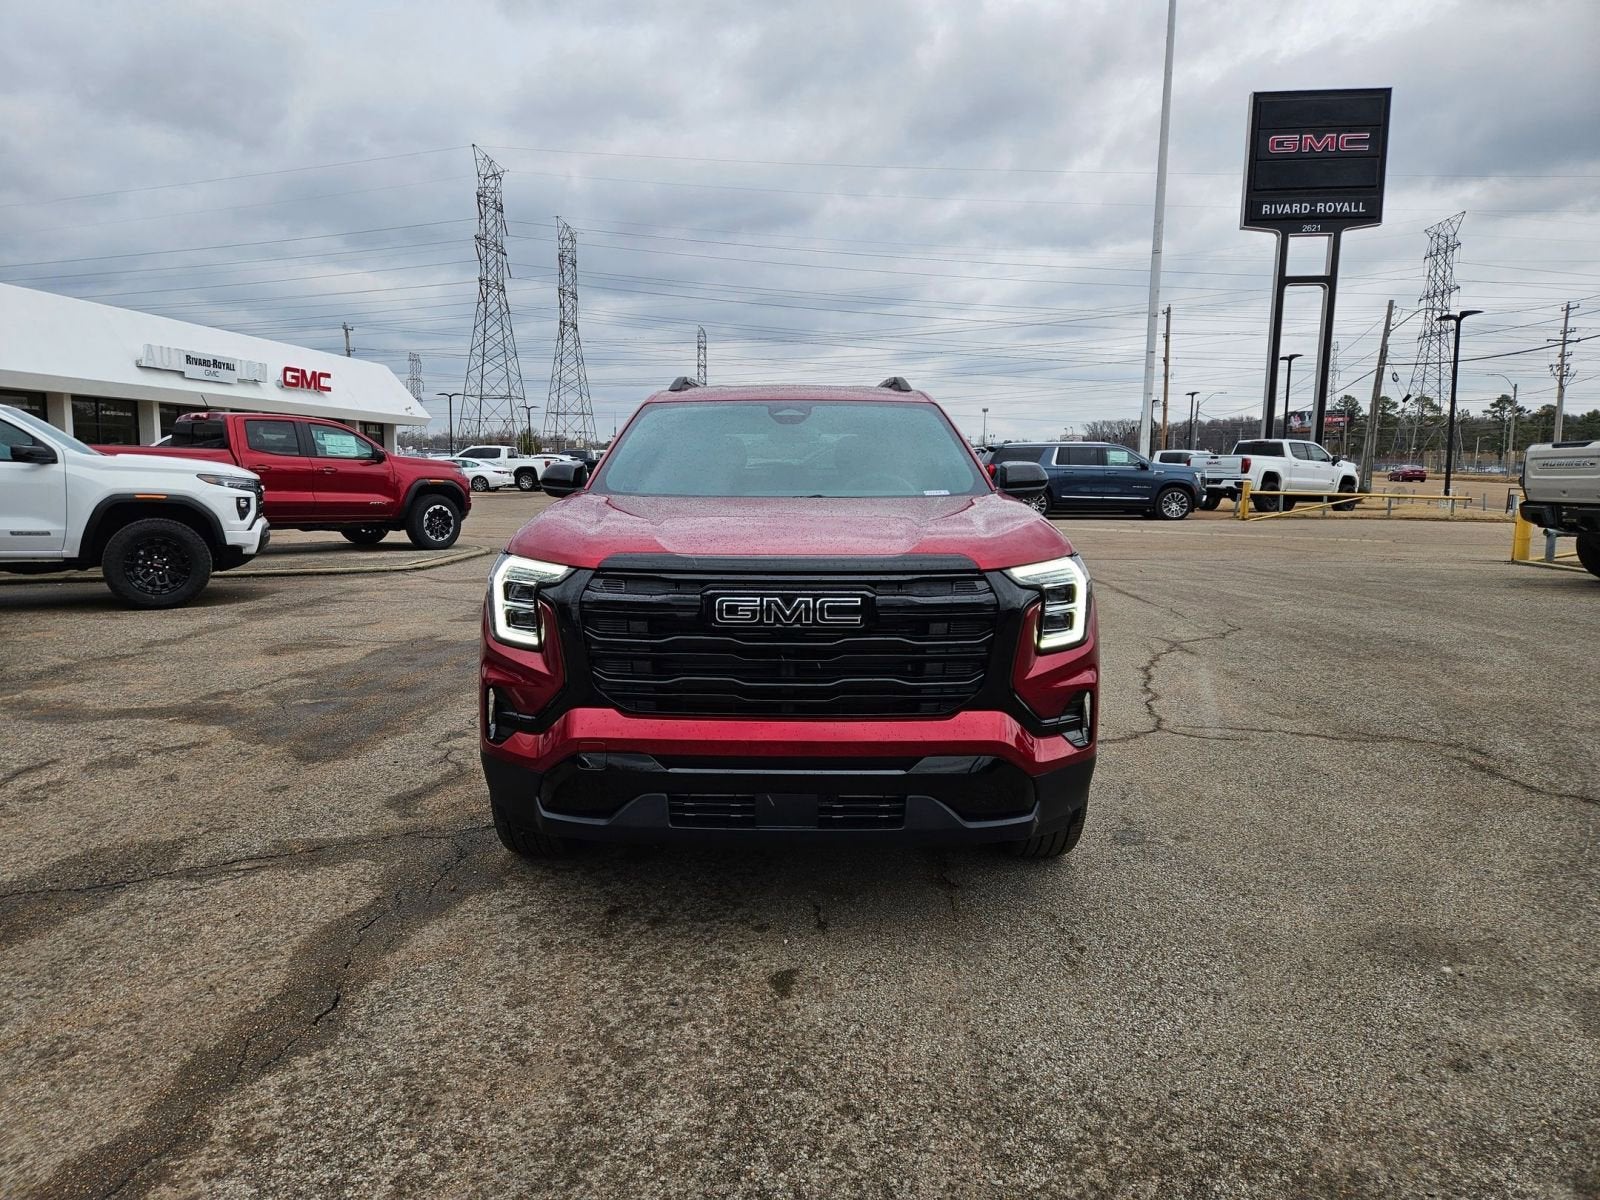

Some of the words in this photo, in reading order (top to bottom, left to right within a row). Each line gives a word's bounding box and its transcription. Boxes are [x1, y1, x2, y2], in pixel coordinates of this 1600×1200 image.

[1268, 133, 1370, 153] GMC
[1262, 202, 1366, 215] RIVARD-ROYALL
[1302, 224, 1321, 232] 2621
[283, 366, 332, 392] GMC
[715, 597, 861, 624] GMC
